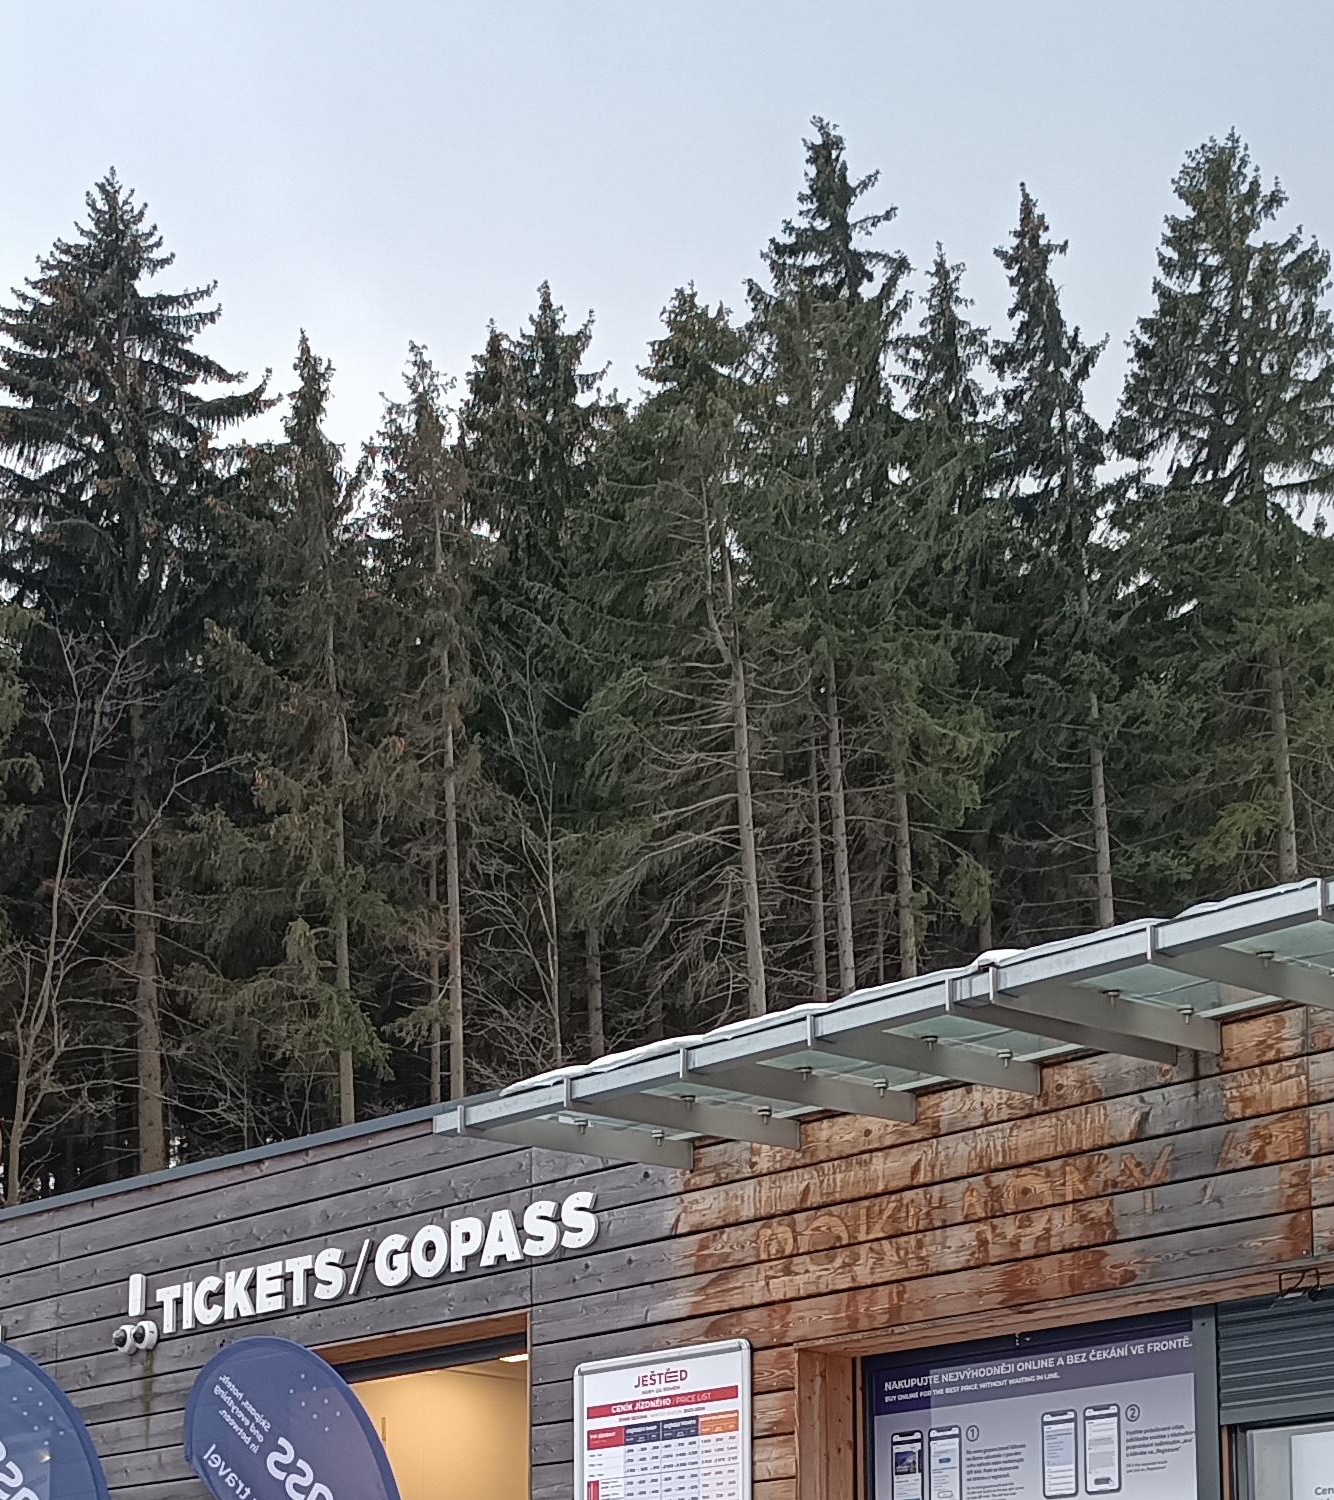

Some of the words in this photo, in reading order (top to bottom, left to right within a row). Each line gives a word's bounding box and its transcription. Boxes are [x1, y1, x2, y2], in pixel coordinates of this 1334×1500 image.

[634, 1368, 688, 1389] JEŠTĚD
[884, 1374, 940, 1391] NAKUPUJTE
[941, 1362, 1014, 1383] NEJVÝHODNĚJI
[1017, 1357, 1055, 1371] ONLINE
[1056, 1356, 1064, 1366] A
[1067, 1353, 1087, 1365] BEZ
[1089, 1344, 1129, 1361] ČEKÁNÍ
[1129, 1344, 1145, 1355] VE
